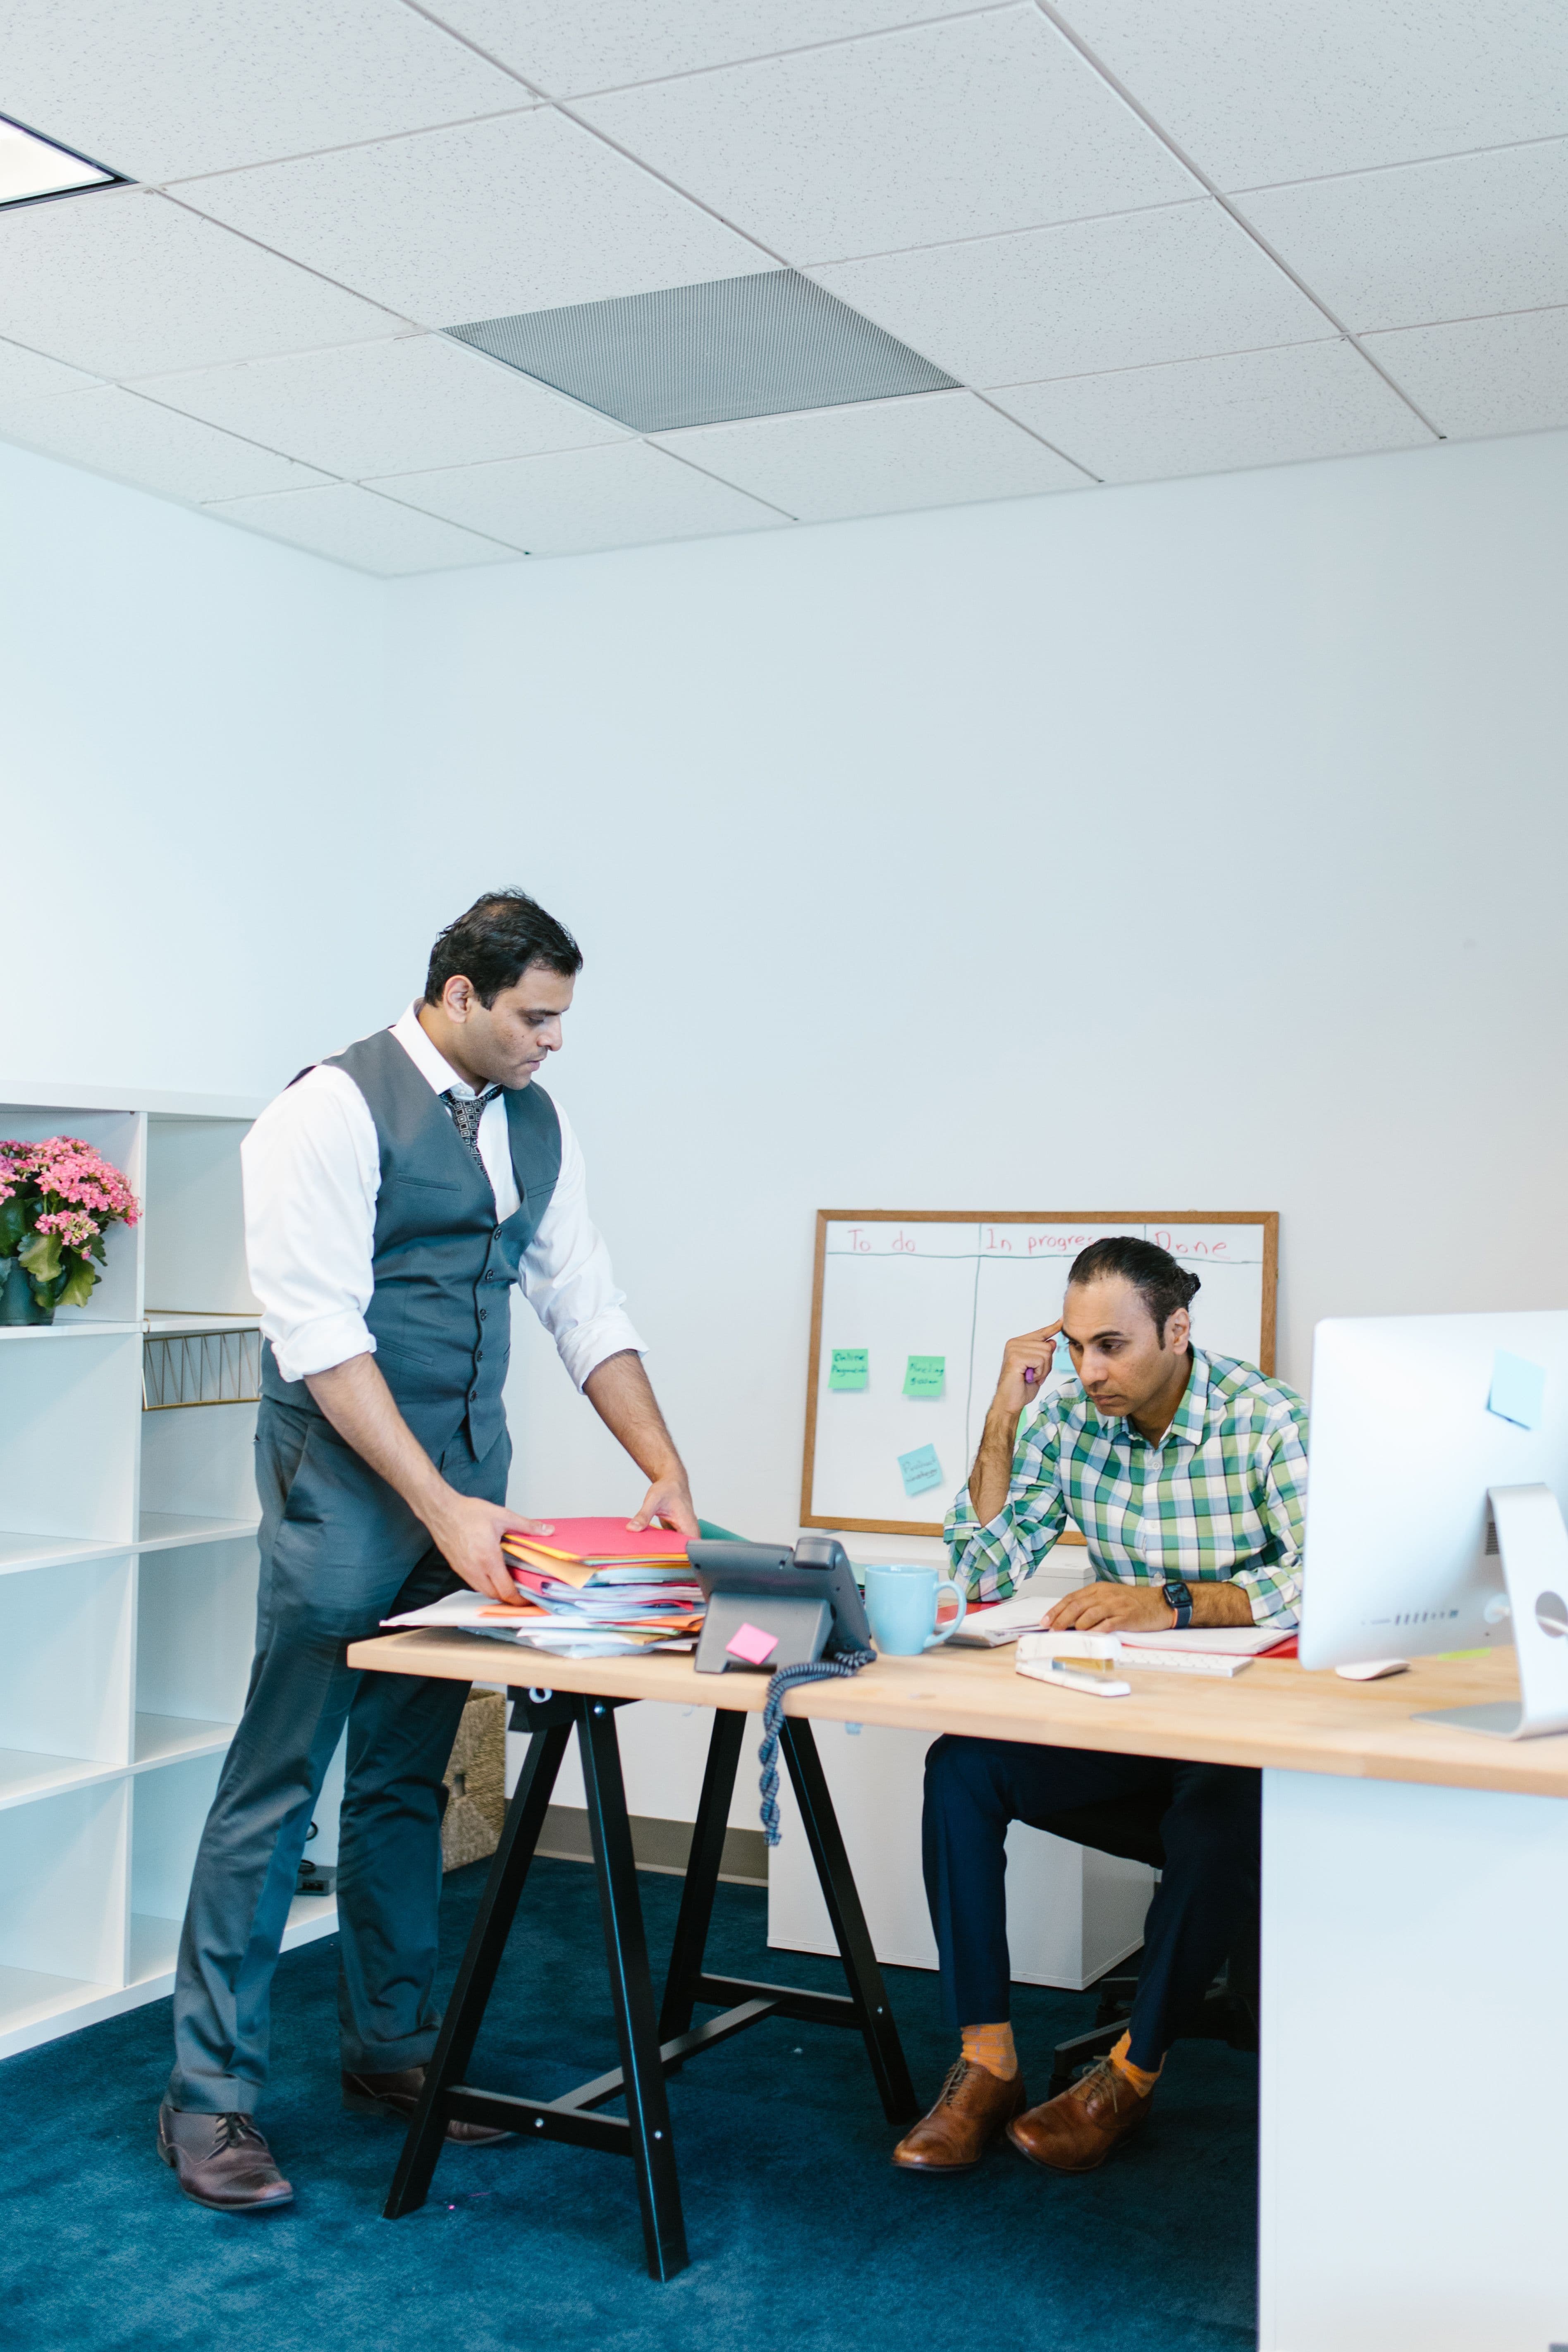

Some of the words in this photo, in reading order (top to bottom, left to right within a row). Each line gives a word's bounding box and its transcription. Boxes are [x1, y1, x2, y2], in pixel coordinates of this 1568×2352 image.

[848, 1228, 871, 1252] To
[892, 1230, 916, 1252] do
[986, 1227, 1012, 1252] In
[1028, 1235, 1112, 1255] progres
[1154, 1230, 1231, 1260] Done
